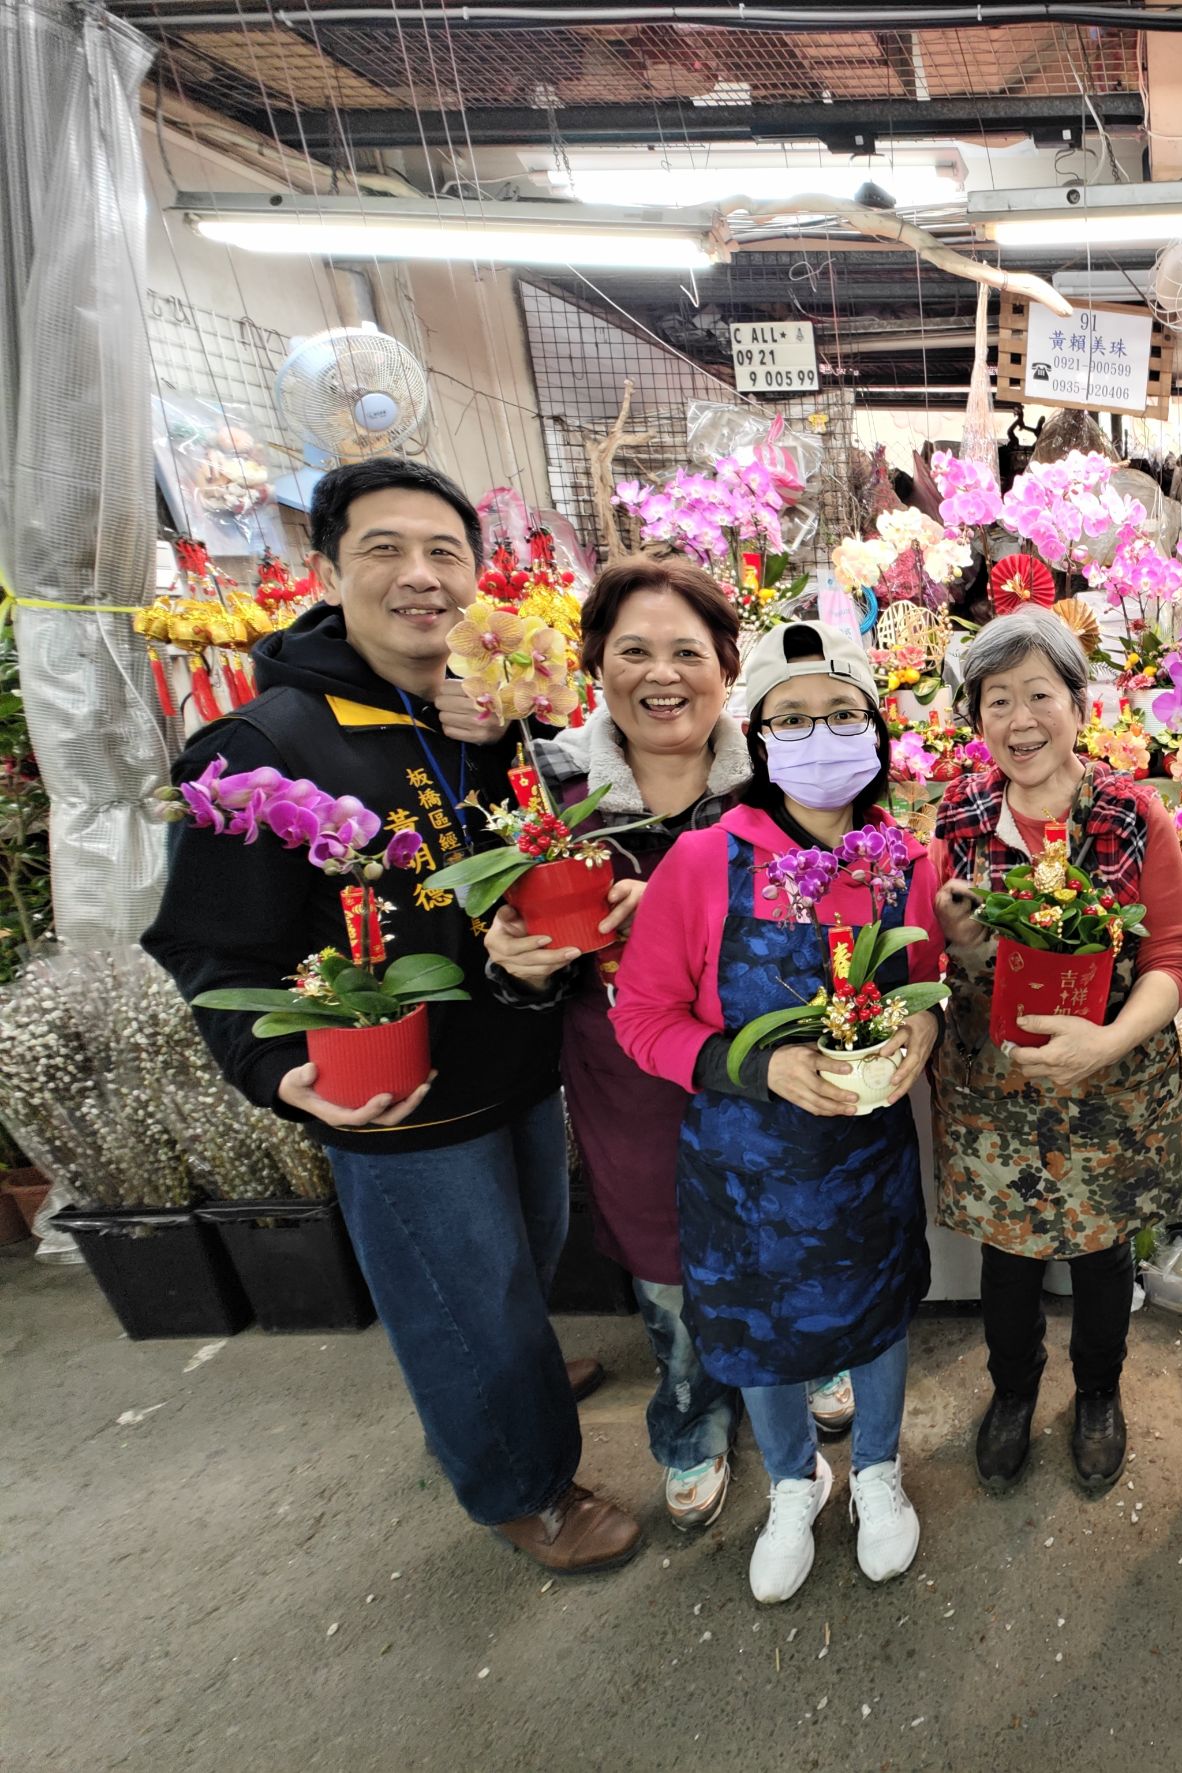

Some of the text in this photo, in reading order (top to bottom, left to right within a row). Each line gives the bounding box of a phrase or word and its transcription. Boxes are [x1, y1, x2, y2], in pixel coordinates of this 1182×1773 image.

[1080, 312, 1098, 332] 91
[1048, 330, 1129, 358] 黃賴美珠
[1053, 355, 1132, 378] 0921-900599
[1051, 379, 1130, 400] 0935-020406
